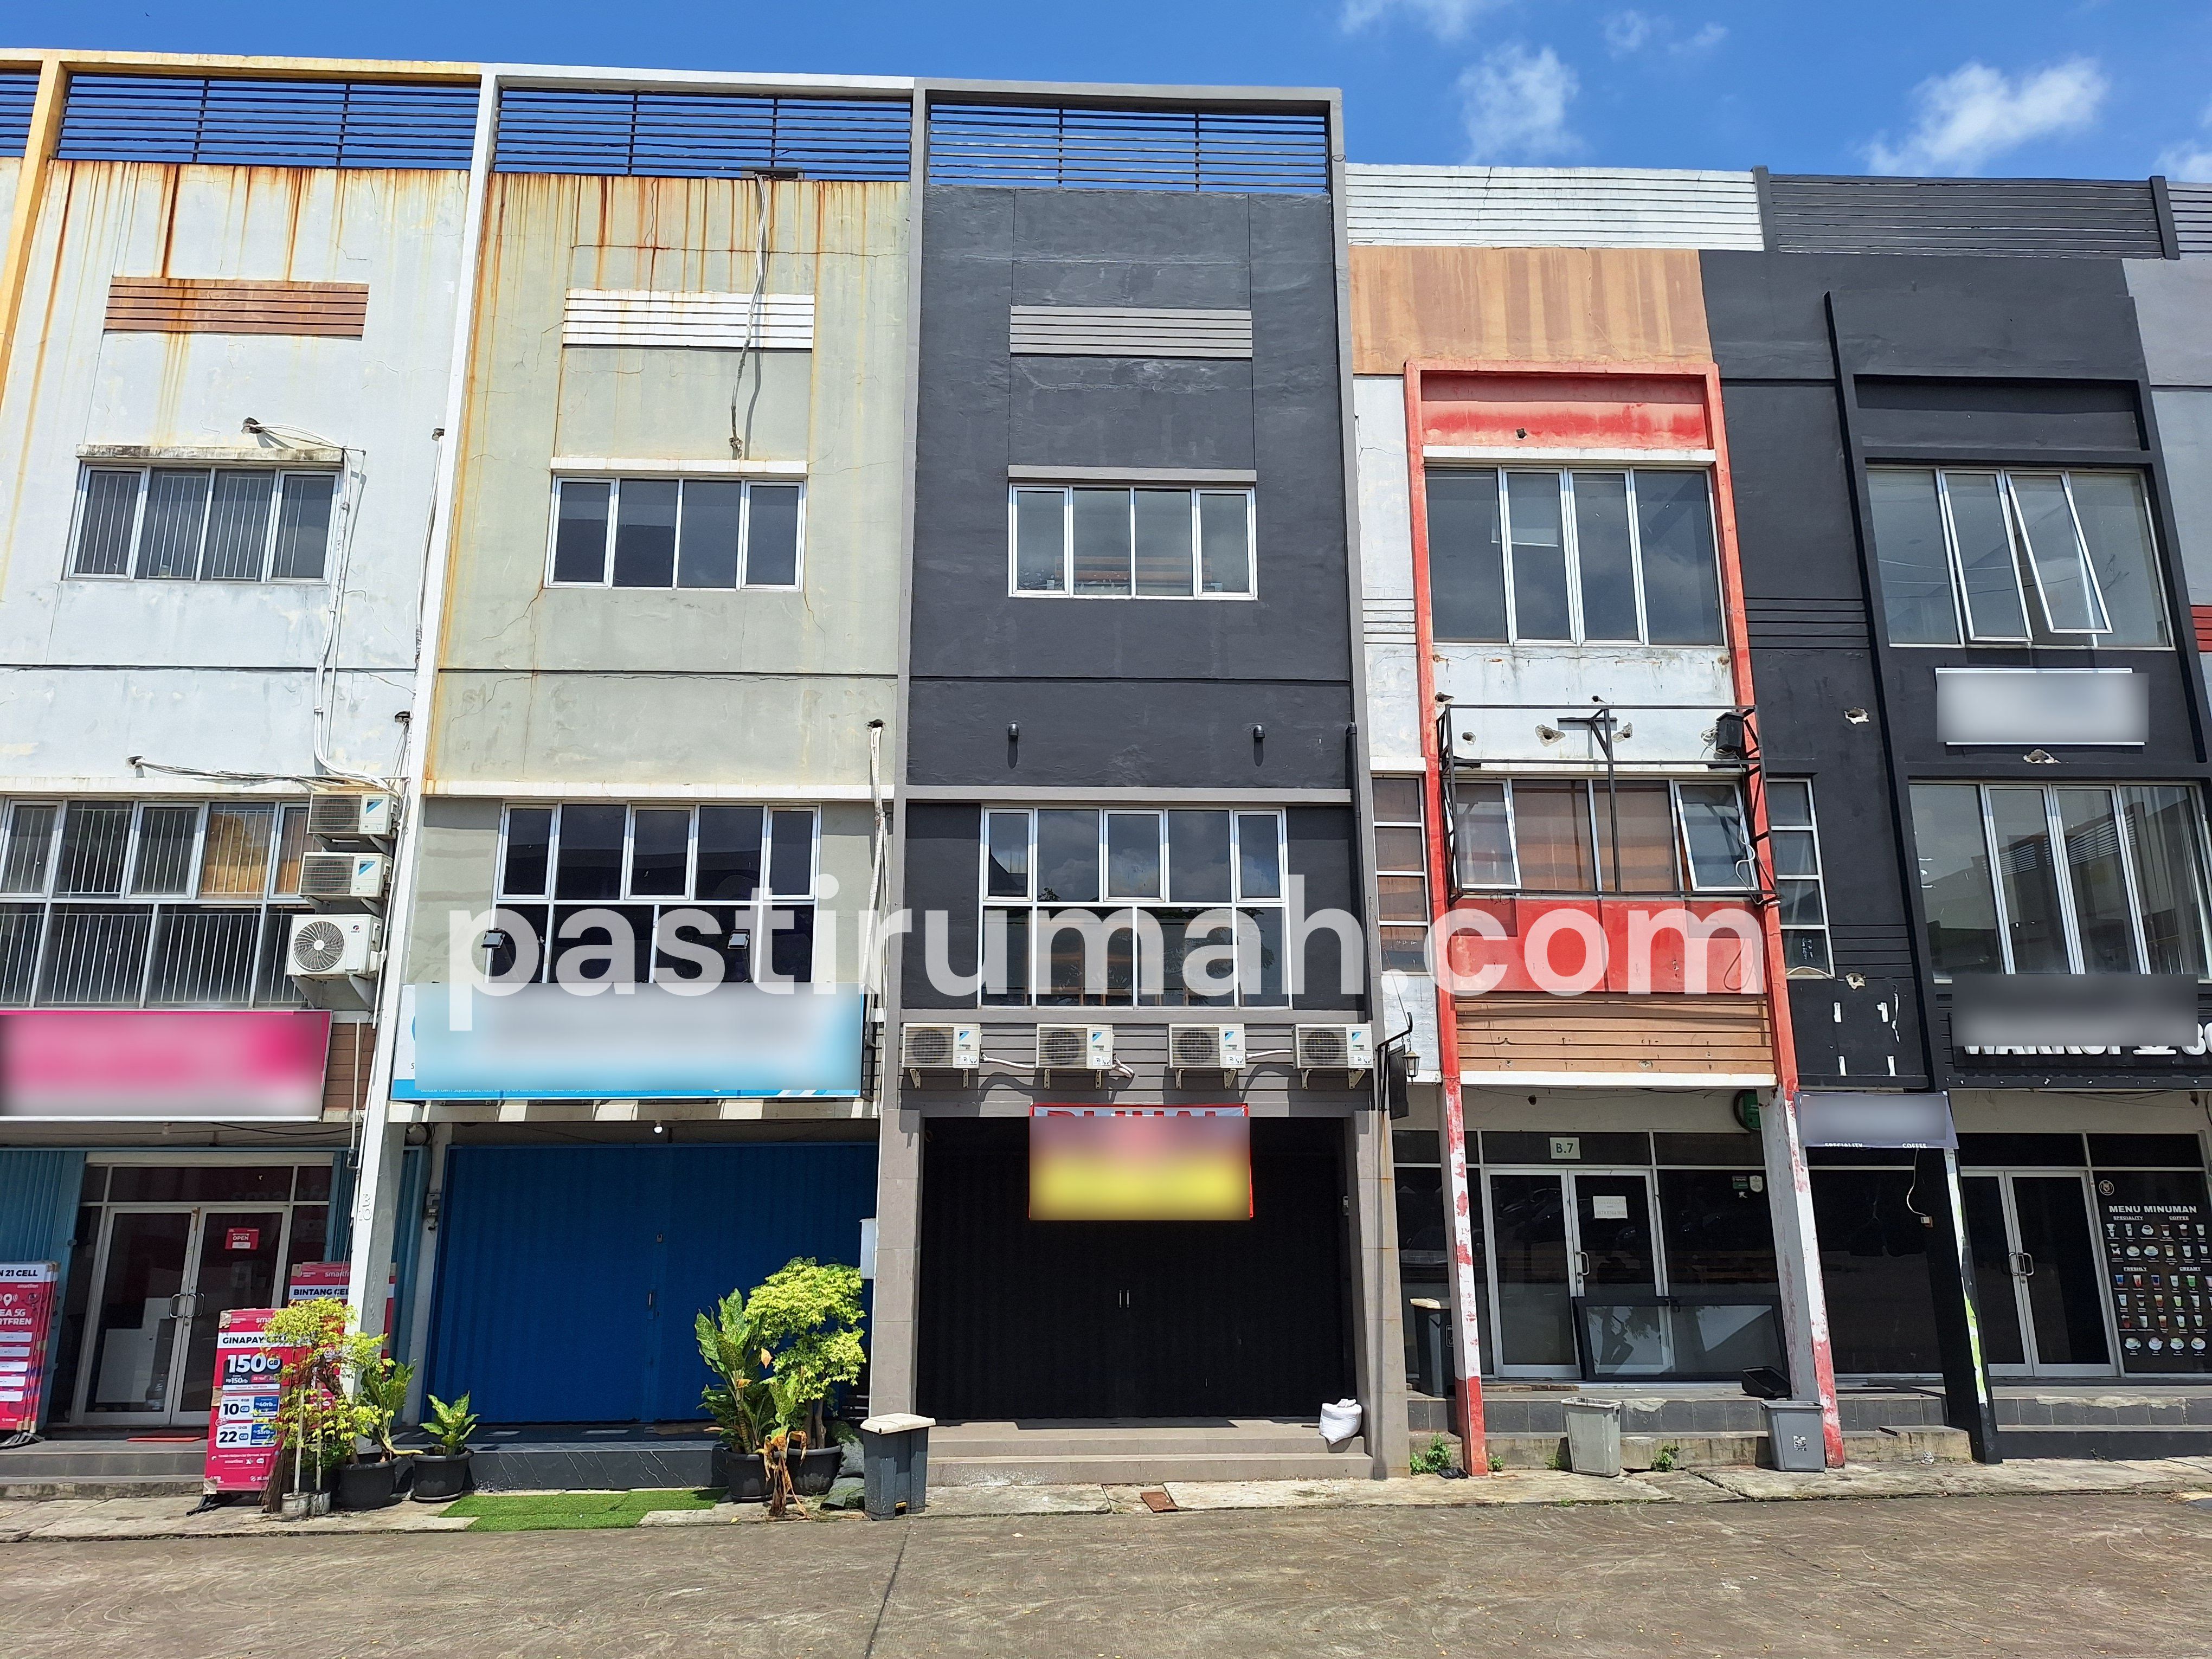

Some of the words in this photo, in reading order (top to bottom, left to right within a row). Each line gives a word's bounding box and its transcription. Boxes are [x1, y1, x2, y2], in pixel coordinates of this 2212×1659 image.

[1556, 1143, 1573, 1153] B.7
[14, 1308, 26, 1317] 5G
[228, 1353, 267, 1373] 150
[223, 1403, 239, 1415] 10
[219, 1431, 237, 1443] 22
